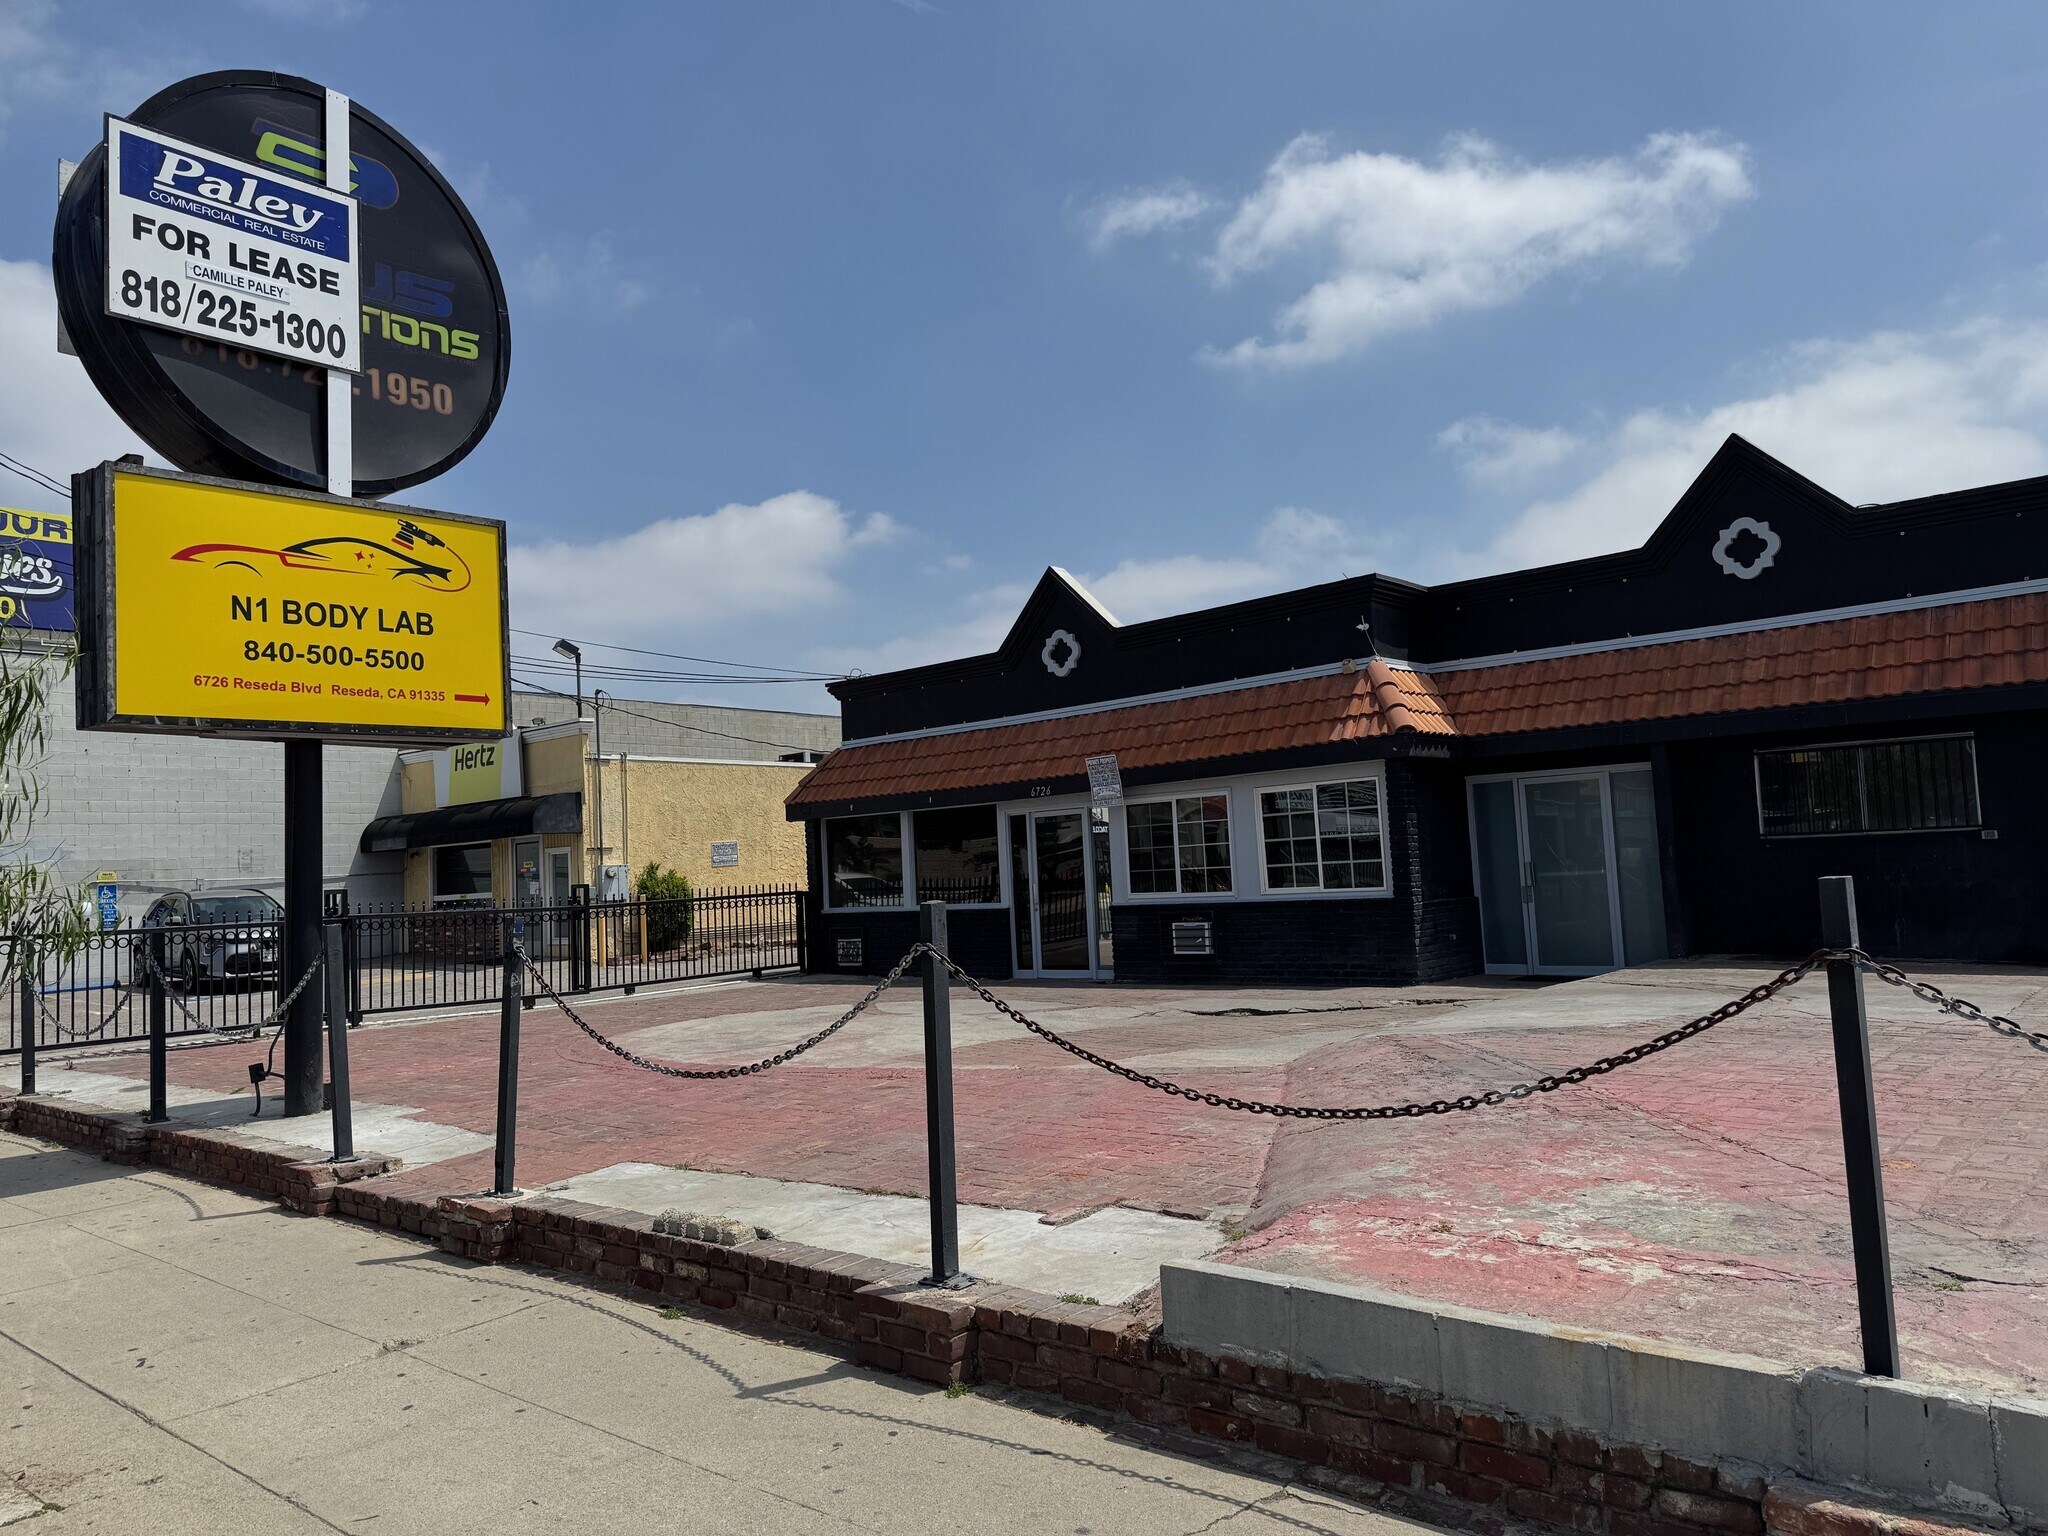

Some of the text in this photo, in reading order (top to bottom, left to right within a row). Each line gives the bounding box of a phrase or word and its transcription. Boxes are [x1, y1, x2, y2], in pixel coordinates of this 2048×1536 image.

[154, 150, 324, 233] Paley
[149, 190, 326, 251] COMMERCIAL REAL ESTATE
[132, 213, 340, 296] FOR LEASE
[192, 265, 284, 298] CAMILLE PALEY
[121, 269, 346, 358] 818/225-1300
[230, 594, 435, 636] N1 BODY LAB
[243, 640, 425, 671] 840-500-5500
[193, 674, 446, 702] 6726 Reseda Blvd Reseda, CA 91335
[454, 744, 495, 771] Hertz
[1030, 786, 1051, 798] 6726
